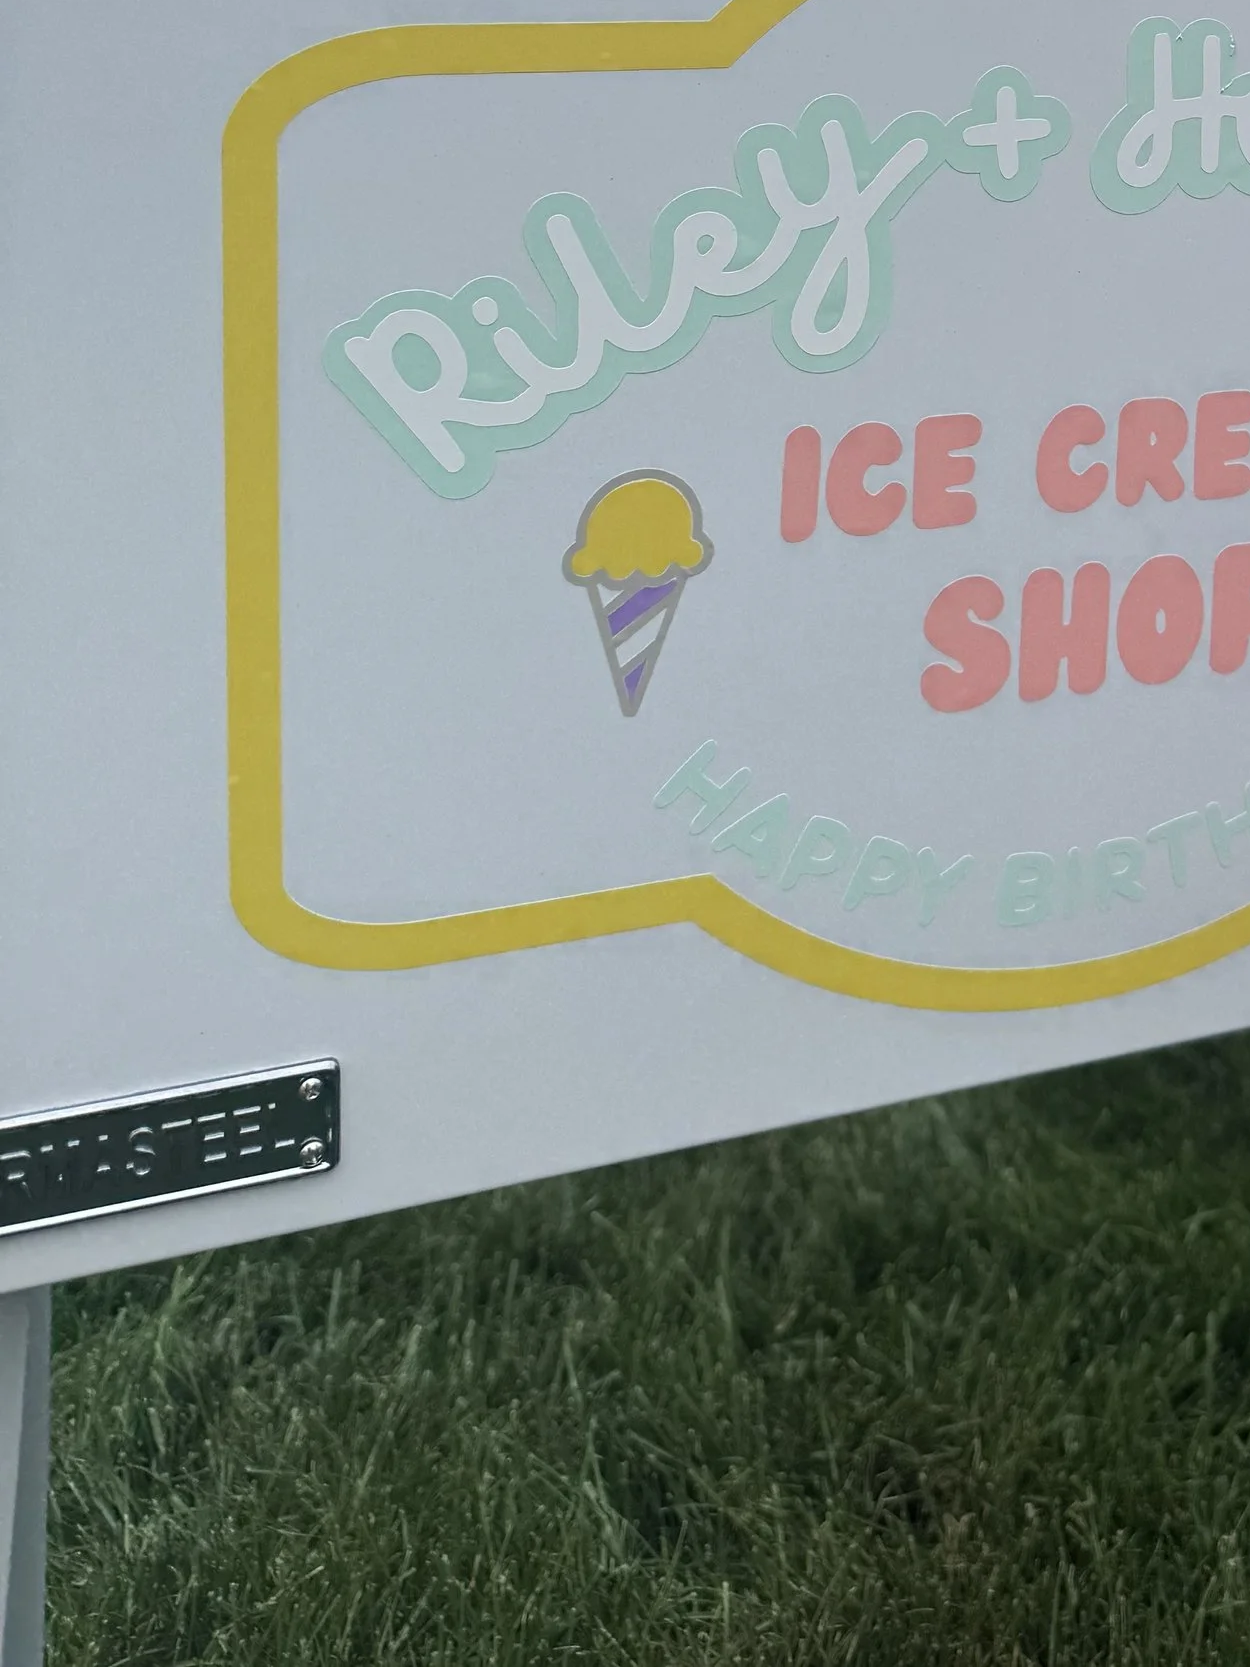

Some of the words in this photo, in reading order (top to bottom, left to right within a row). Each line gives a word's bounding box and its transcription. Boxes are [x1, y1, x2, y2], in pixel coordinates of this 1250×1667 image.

[322, 94, 928, 499] Riley
[780, 412, 983, 543] ICE
[653, 738, 976, 927] HAPPY
